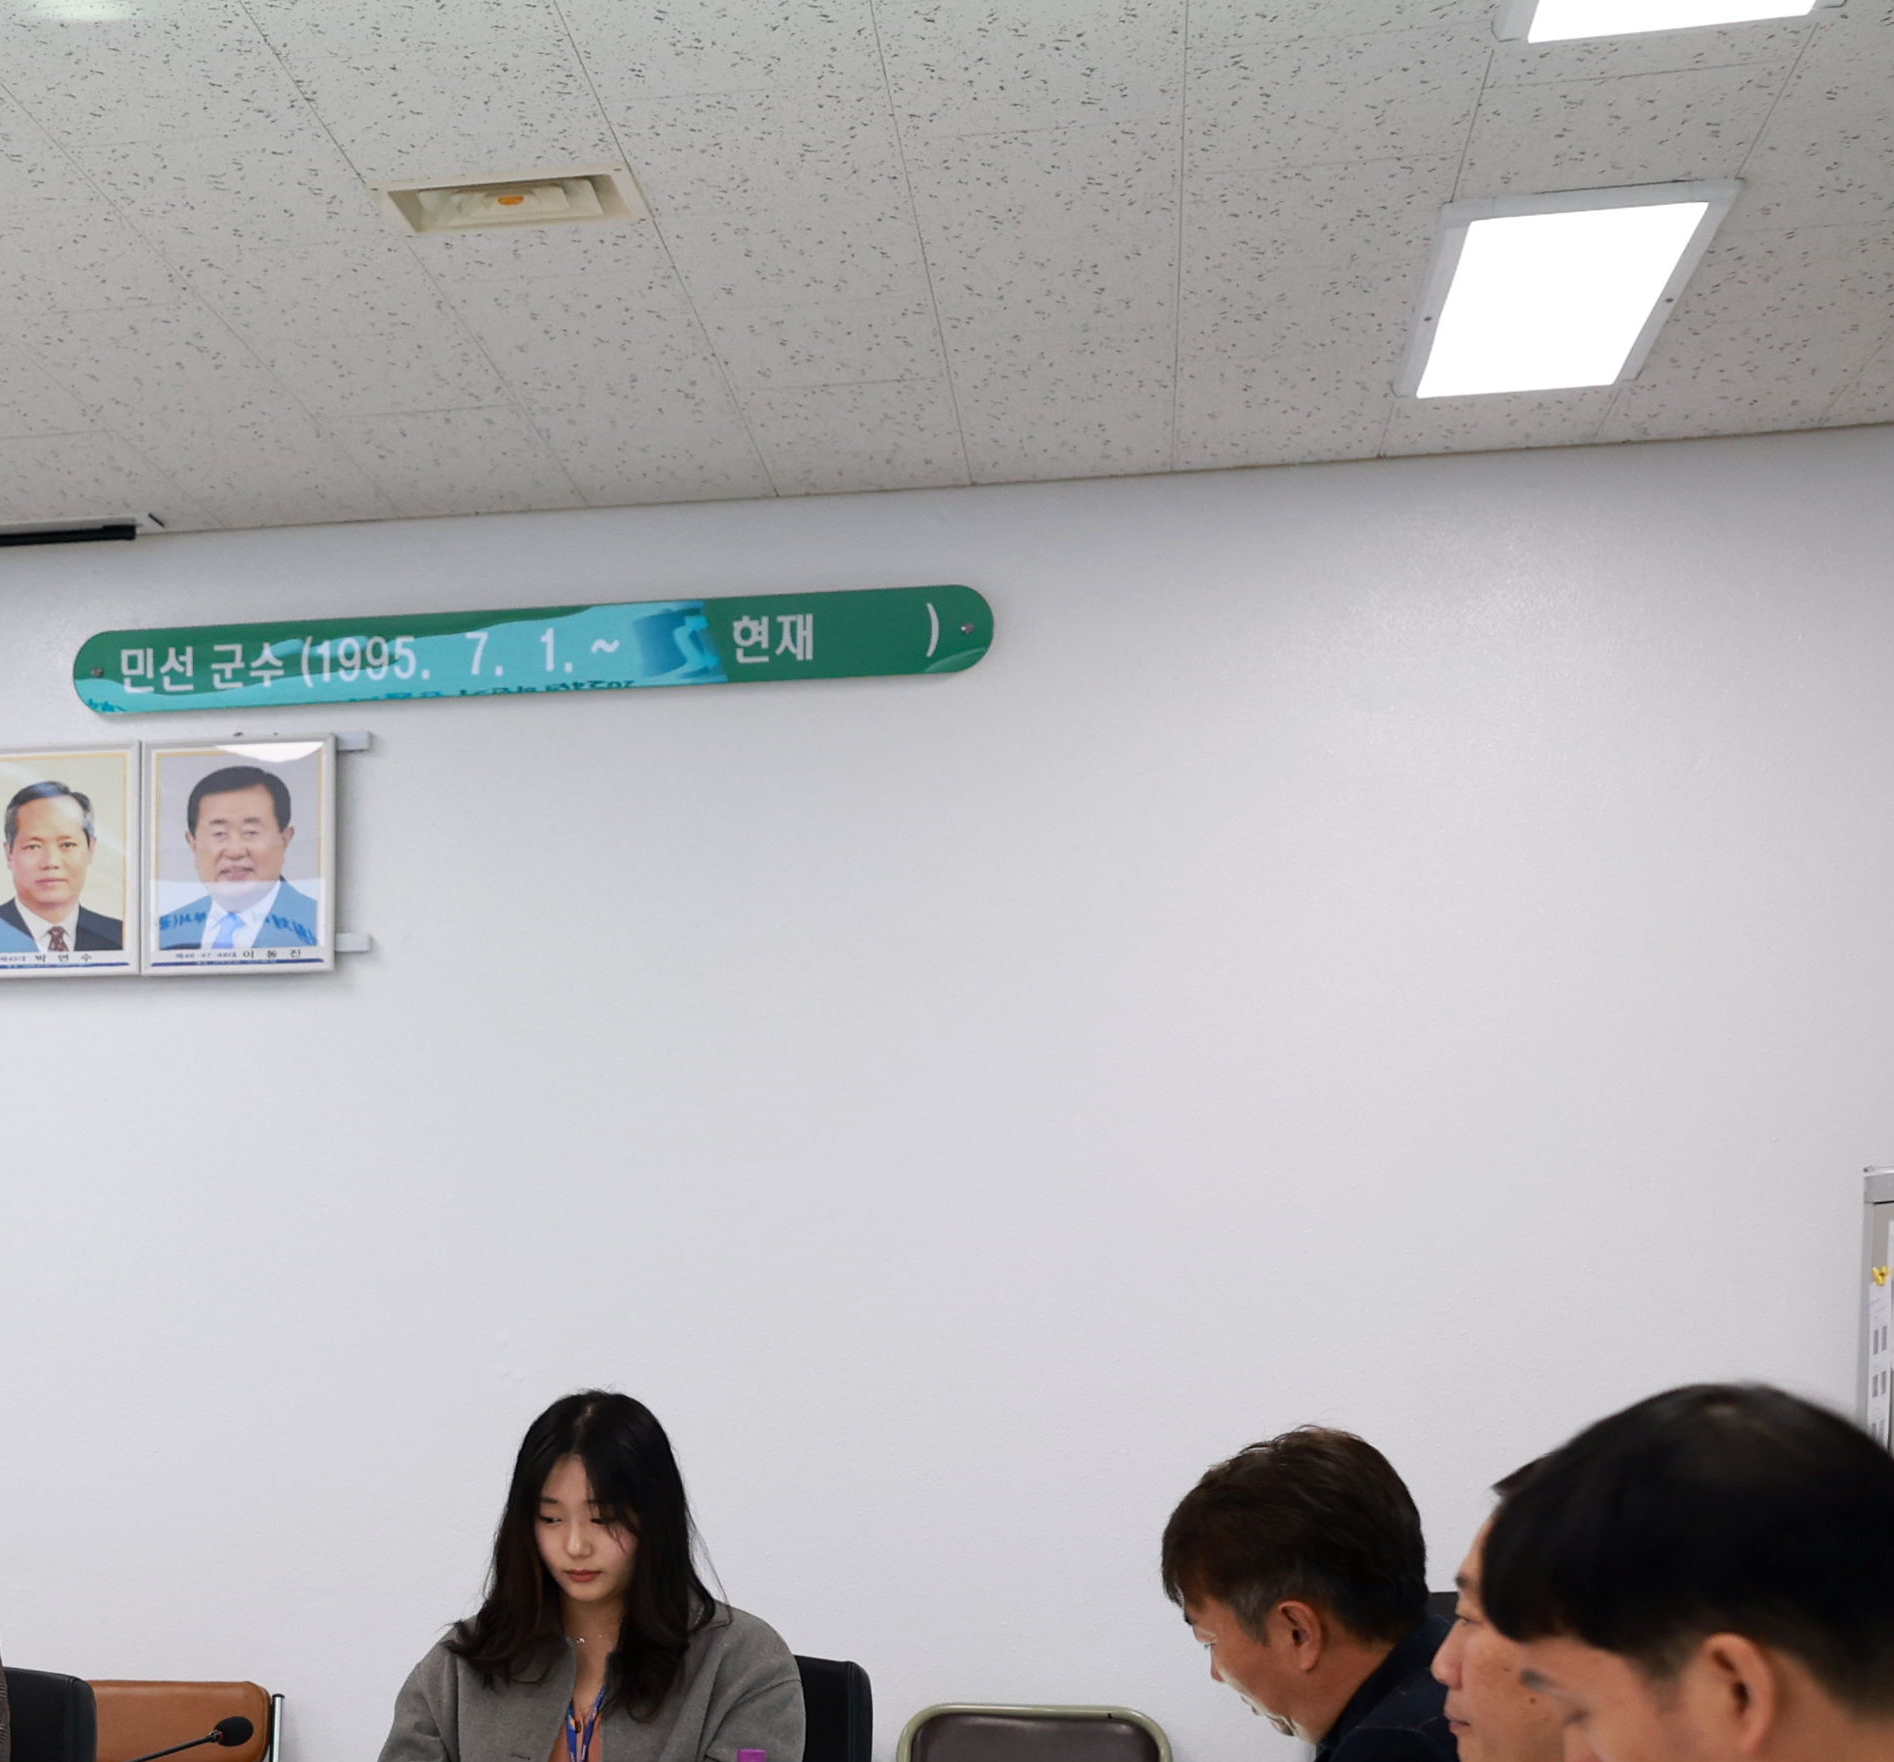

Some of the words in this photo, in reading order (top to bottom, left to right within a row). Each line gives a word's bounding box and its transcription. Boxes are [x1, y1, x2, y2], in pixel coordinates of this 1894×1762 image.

[120, 644, 195, 693] 민선
[210, 639, 285, 688] 군수
[300, 632, 430, 683] (1995.
[467, 632, 503, 677] 7.
[541, 629, 574, 674] 1.
[731, 613, 815, 665] 현재
